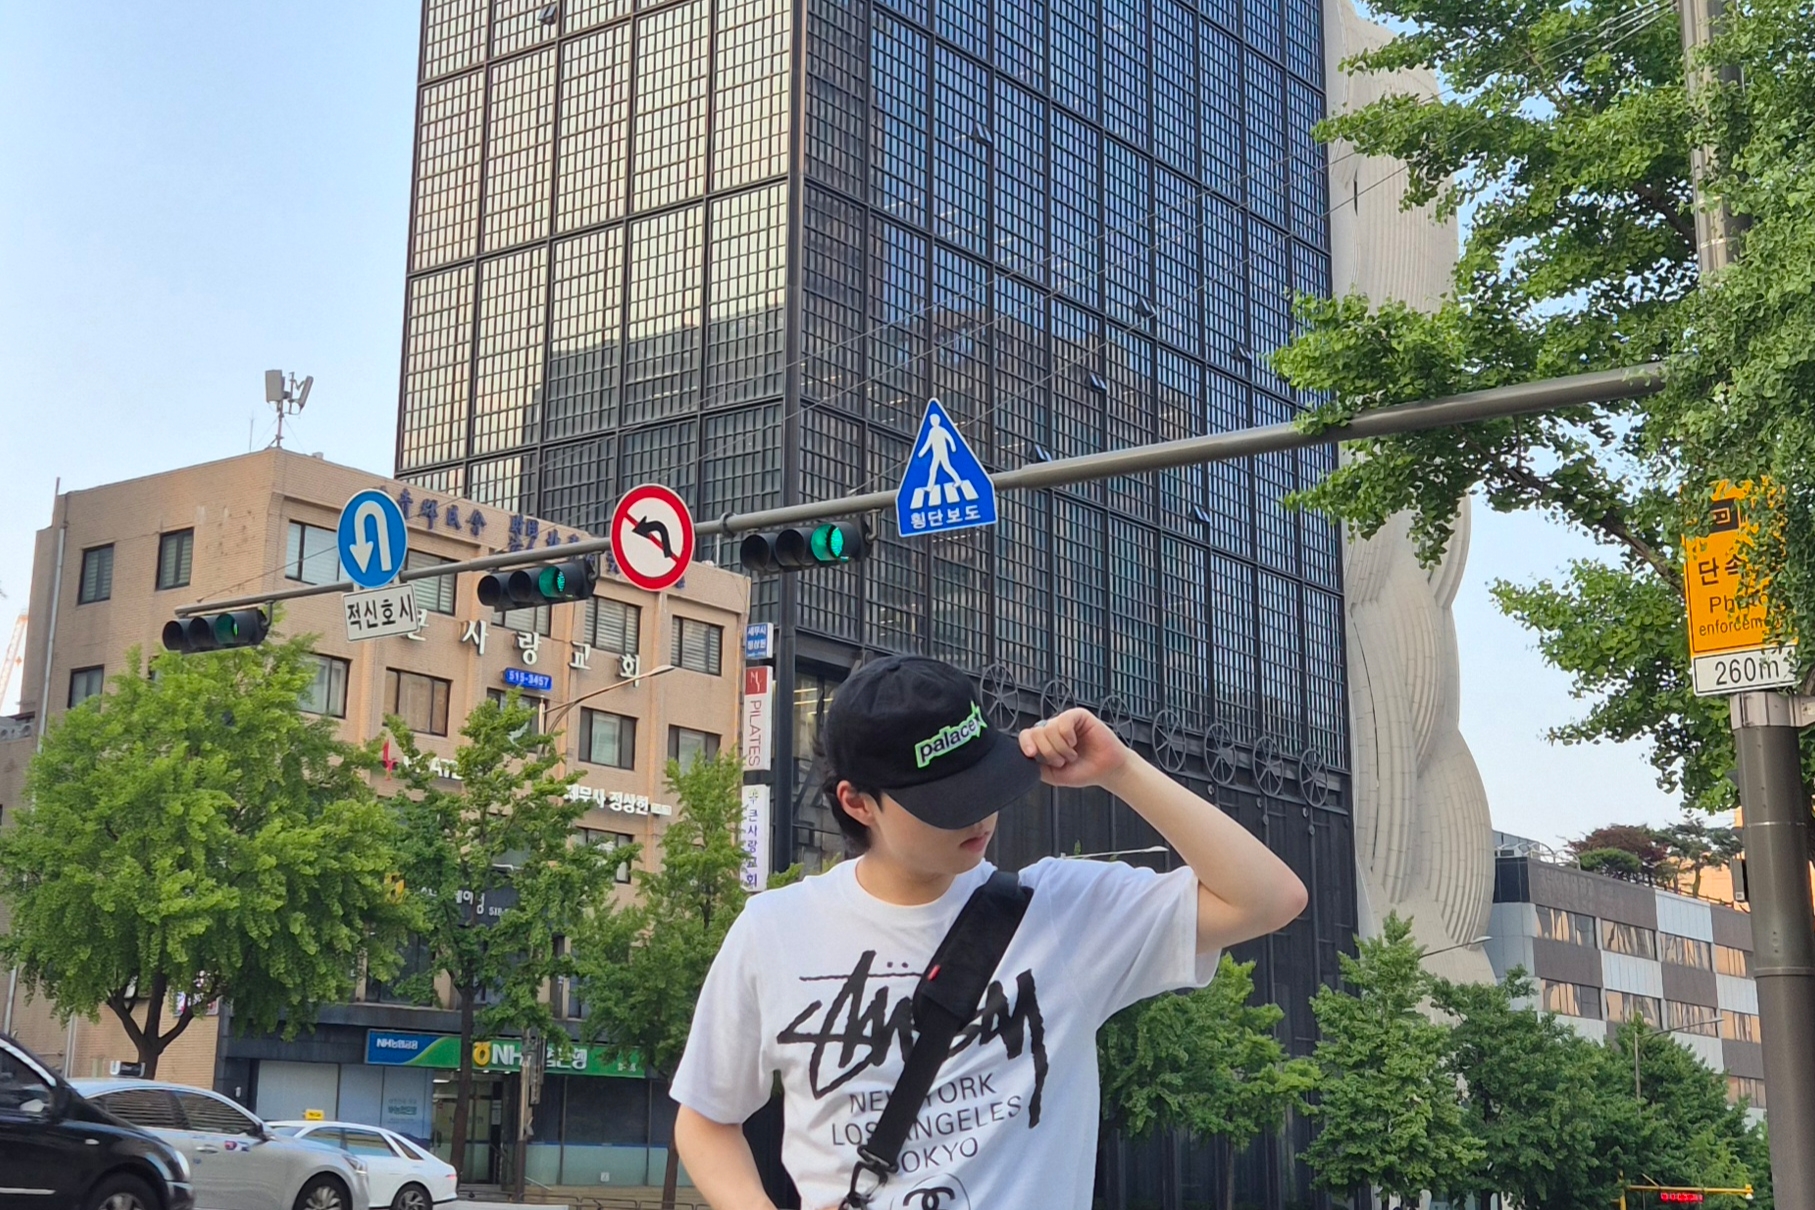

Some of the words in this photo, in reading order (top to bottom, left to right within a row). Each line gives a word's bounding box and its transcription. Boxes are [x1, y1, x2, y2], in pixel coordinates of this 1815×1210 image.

[911, 505, 981, 529] 횡단보도
[347, 594, 414, 631] 적신호시
[1709, 593, 1768, 614] Phto
[1715, 658, 1780, 686] 260m
[748, 699, 762, 767] PILATES
[919, 719, 977, 764] palace
[900, 1136, 979, 1174] OKYO
